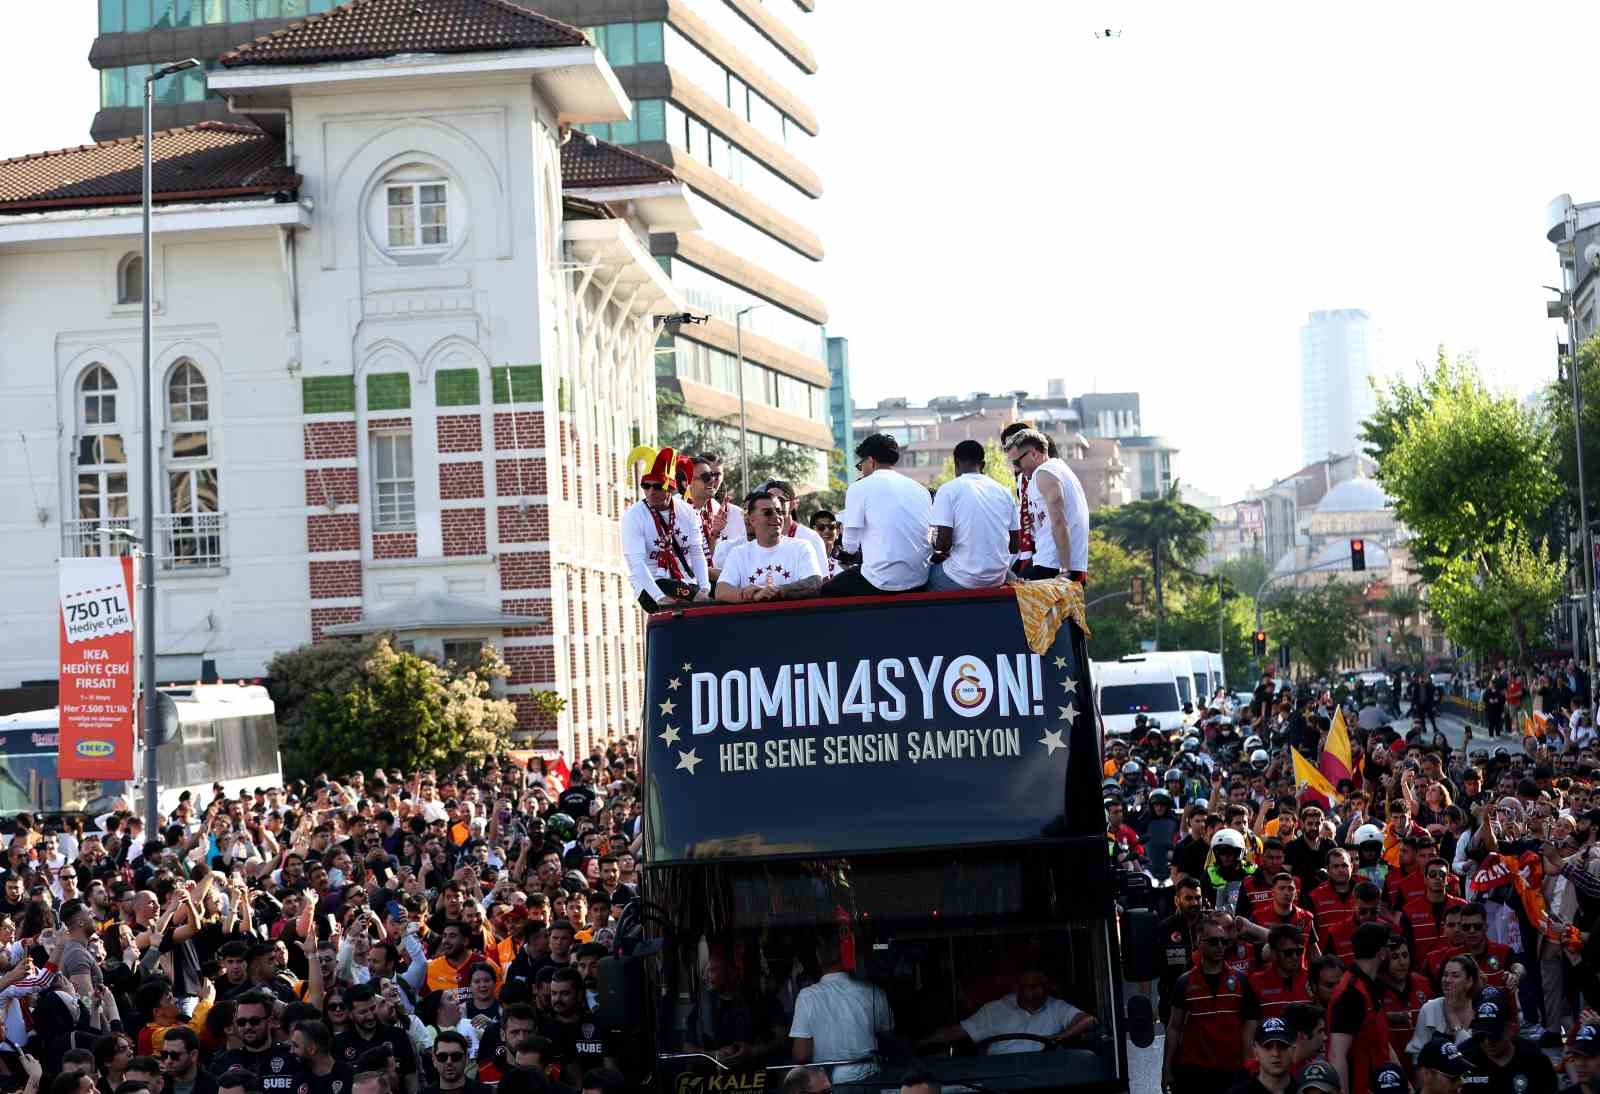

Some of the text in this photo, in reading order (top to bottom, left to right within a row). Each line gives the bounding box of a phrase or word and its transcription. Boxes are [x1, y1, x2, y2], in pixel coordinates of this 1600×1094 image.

[66, 596, 126, 622] 750 TL
[69, 613, 129, 634] Hediye Çeki
[83, 649, 110, 660] IKEA
[62, 661, 129, 677] HEDİYE ÇEKİ
[75, 678, 116, 688] FIRSATI
[719, 741, 759, 773] HER
[765, 737, 817, 769] SENE
[708, 1072, 767, 1090] KALE
